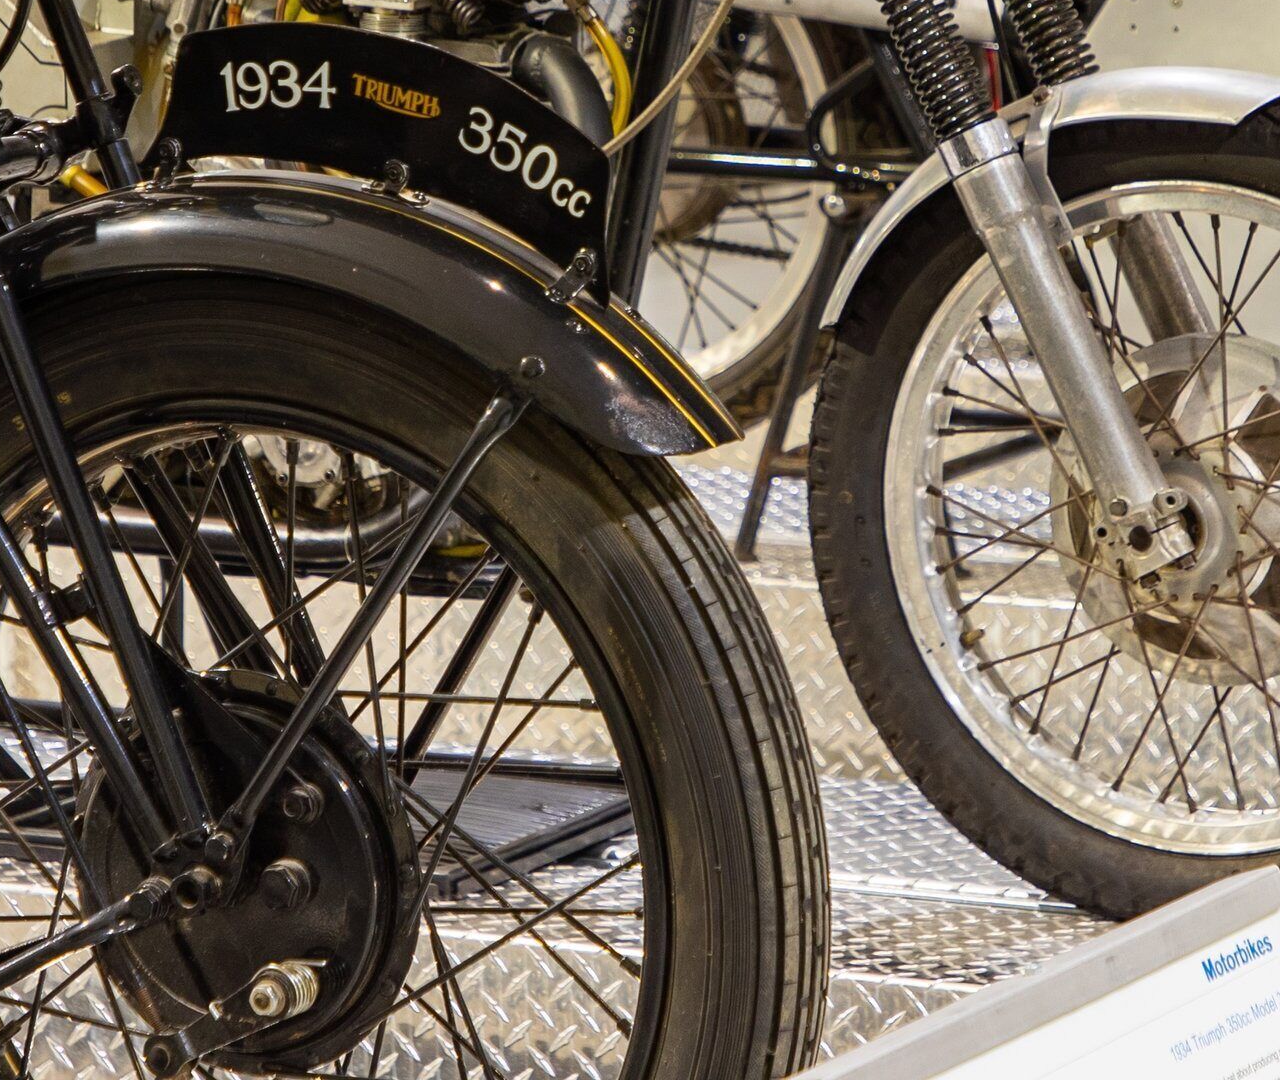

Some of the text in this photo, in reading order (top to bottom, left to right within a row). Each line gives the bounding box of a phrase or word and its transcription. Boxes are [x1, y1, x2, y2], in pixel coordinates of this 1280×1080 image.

[219, 59, 592, 219] 1934 TRIUMPH 350cc
[1201, 935, 1274, 983] Motorbikes
[1170, 1040, 1193, 1062] 1934
[1192, 1022, 1227, 1051] Triumph
[1225, 1011, 1252, 1035] 350cc
[1250, 995, 1278, 1023] Model
